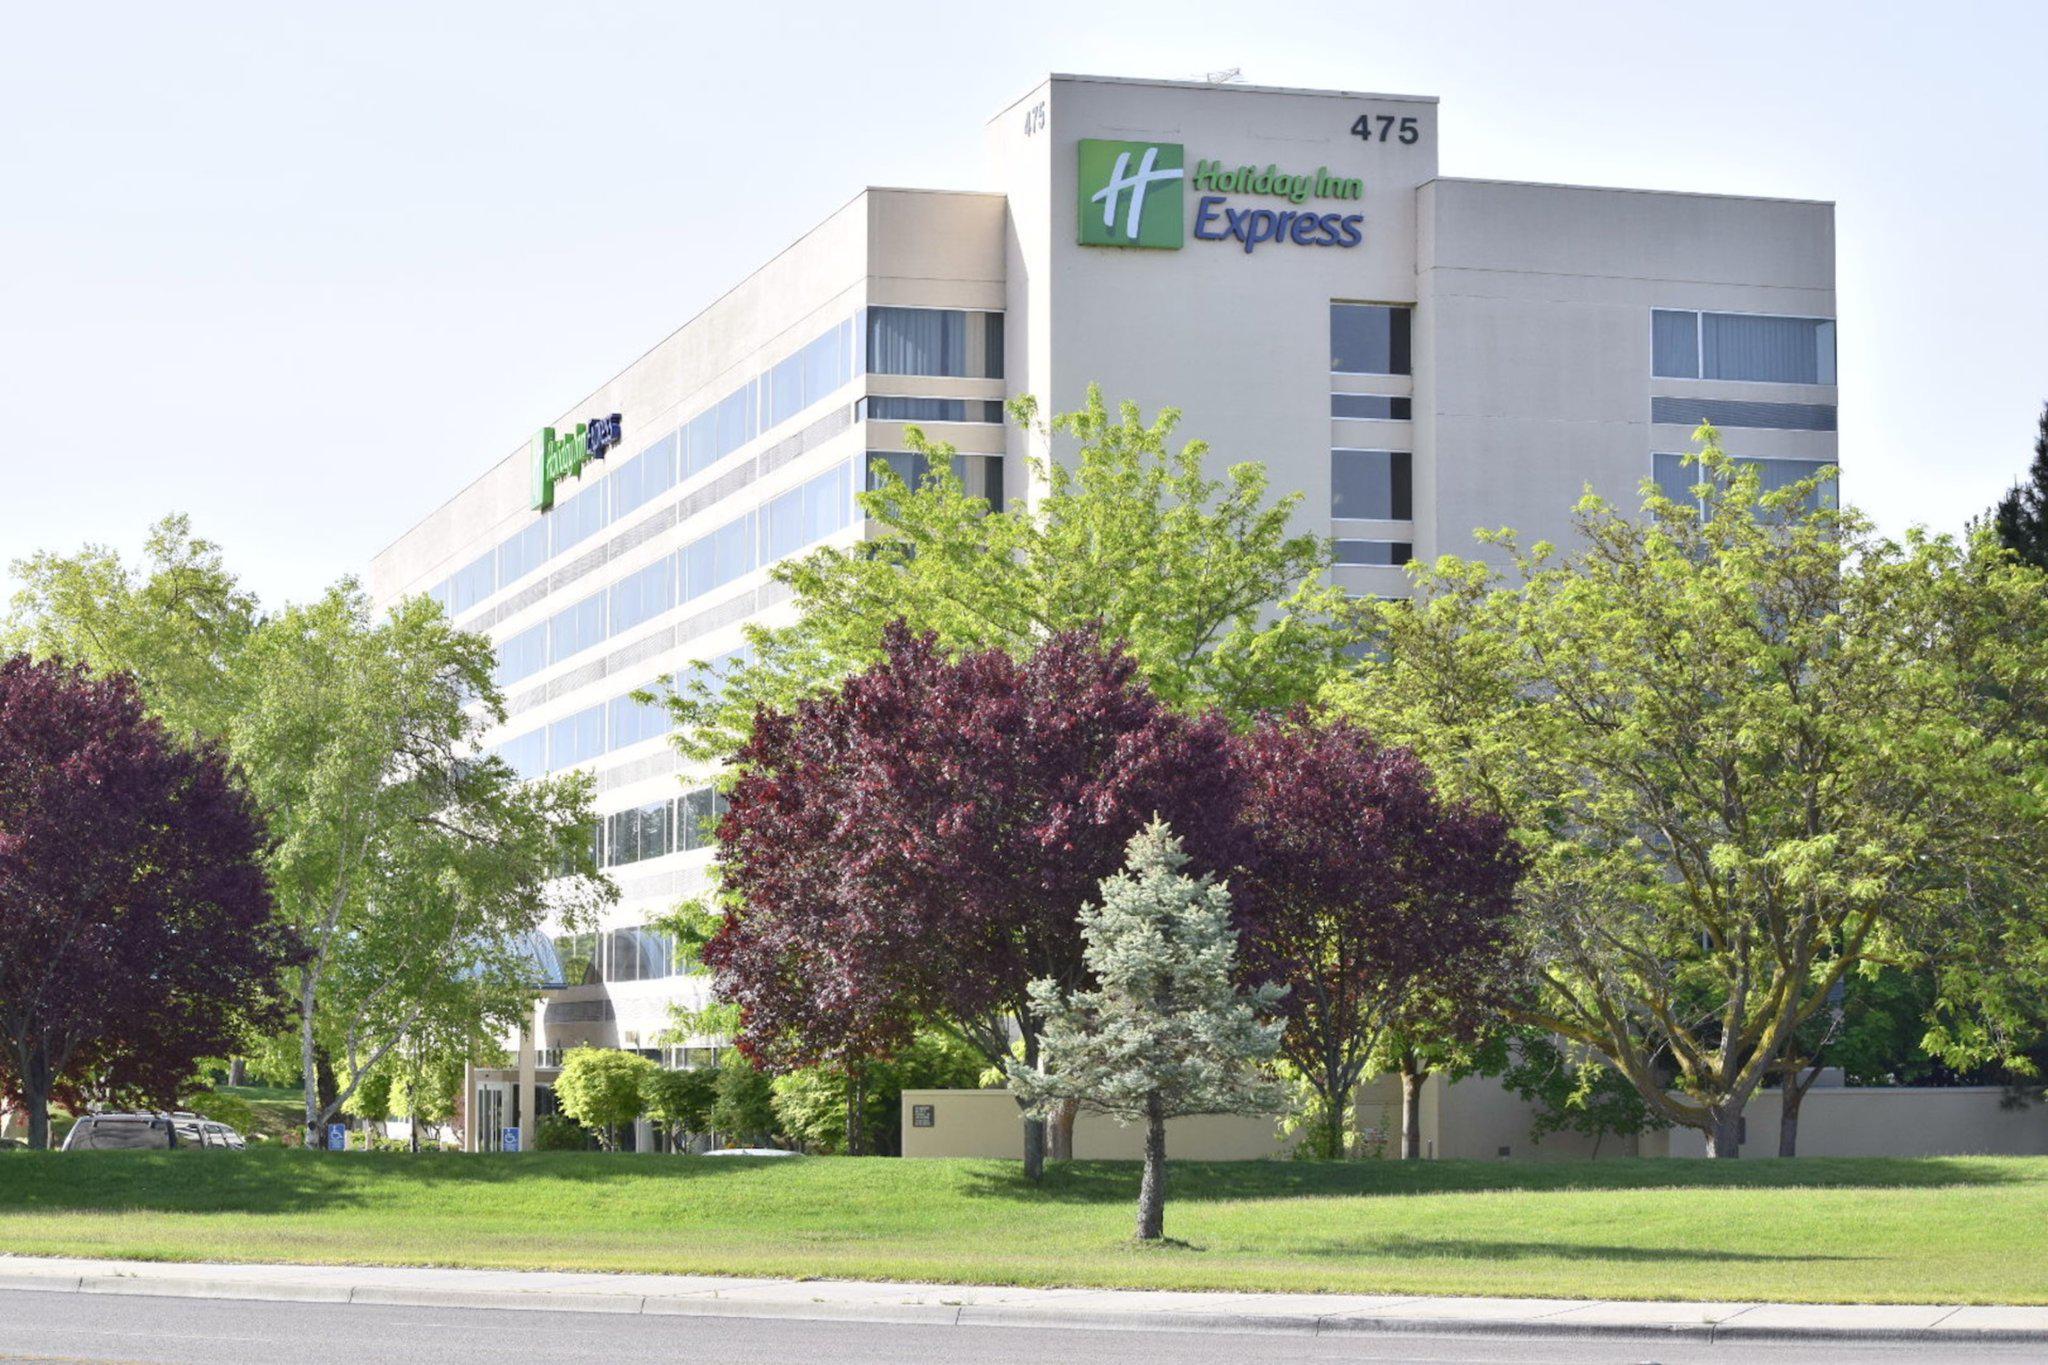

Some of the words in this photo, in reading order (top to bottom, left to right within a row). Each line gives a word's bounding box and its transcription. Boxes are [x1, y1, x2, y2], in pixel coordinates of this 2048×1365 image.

[1024, 101, 1045, 137] 475
[1351, 114, 1419, 145] 475
[1193, 159, 1311, 204] Holiday
[1314, 166, 1364, 200] Inn
[1194, 195, 1364, 254] Express
